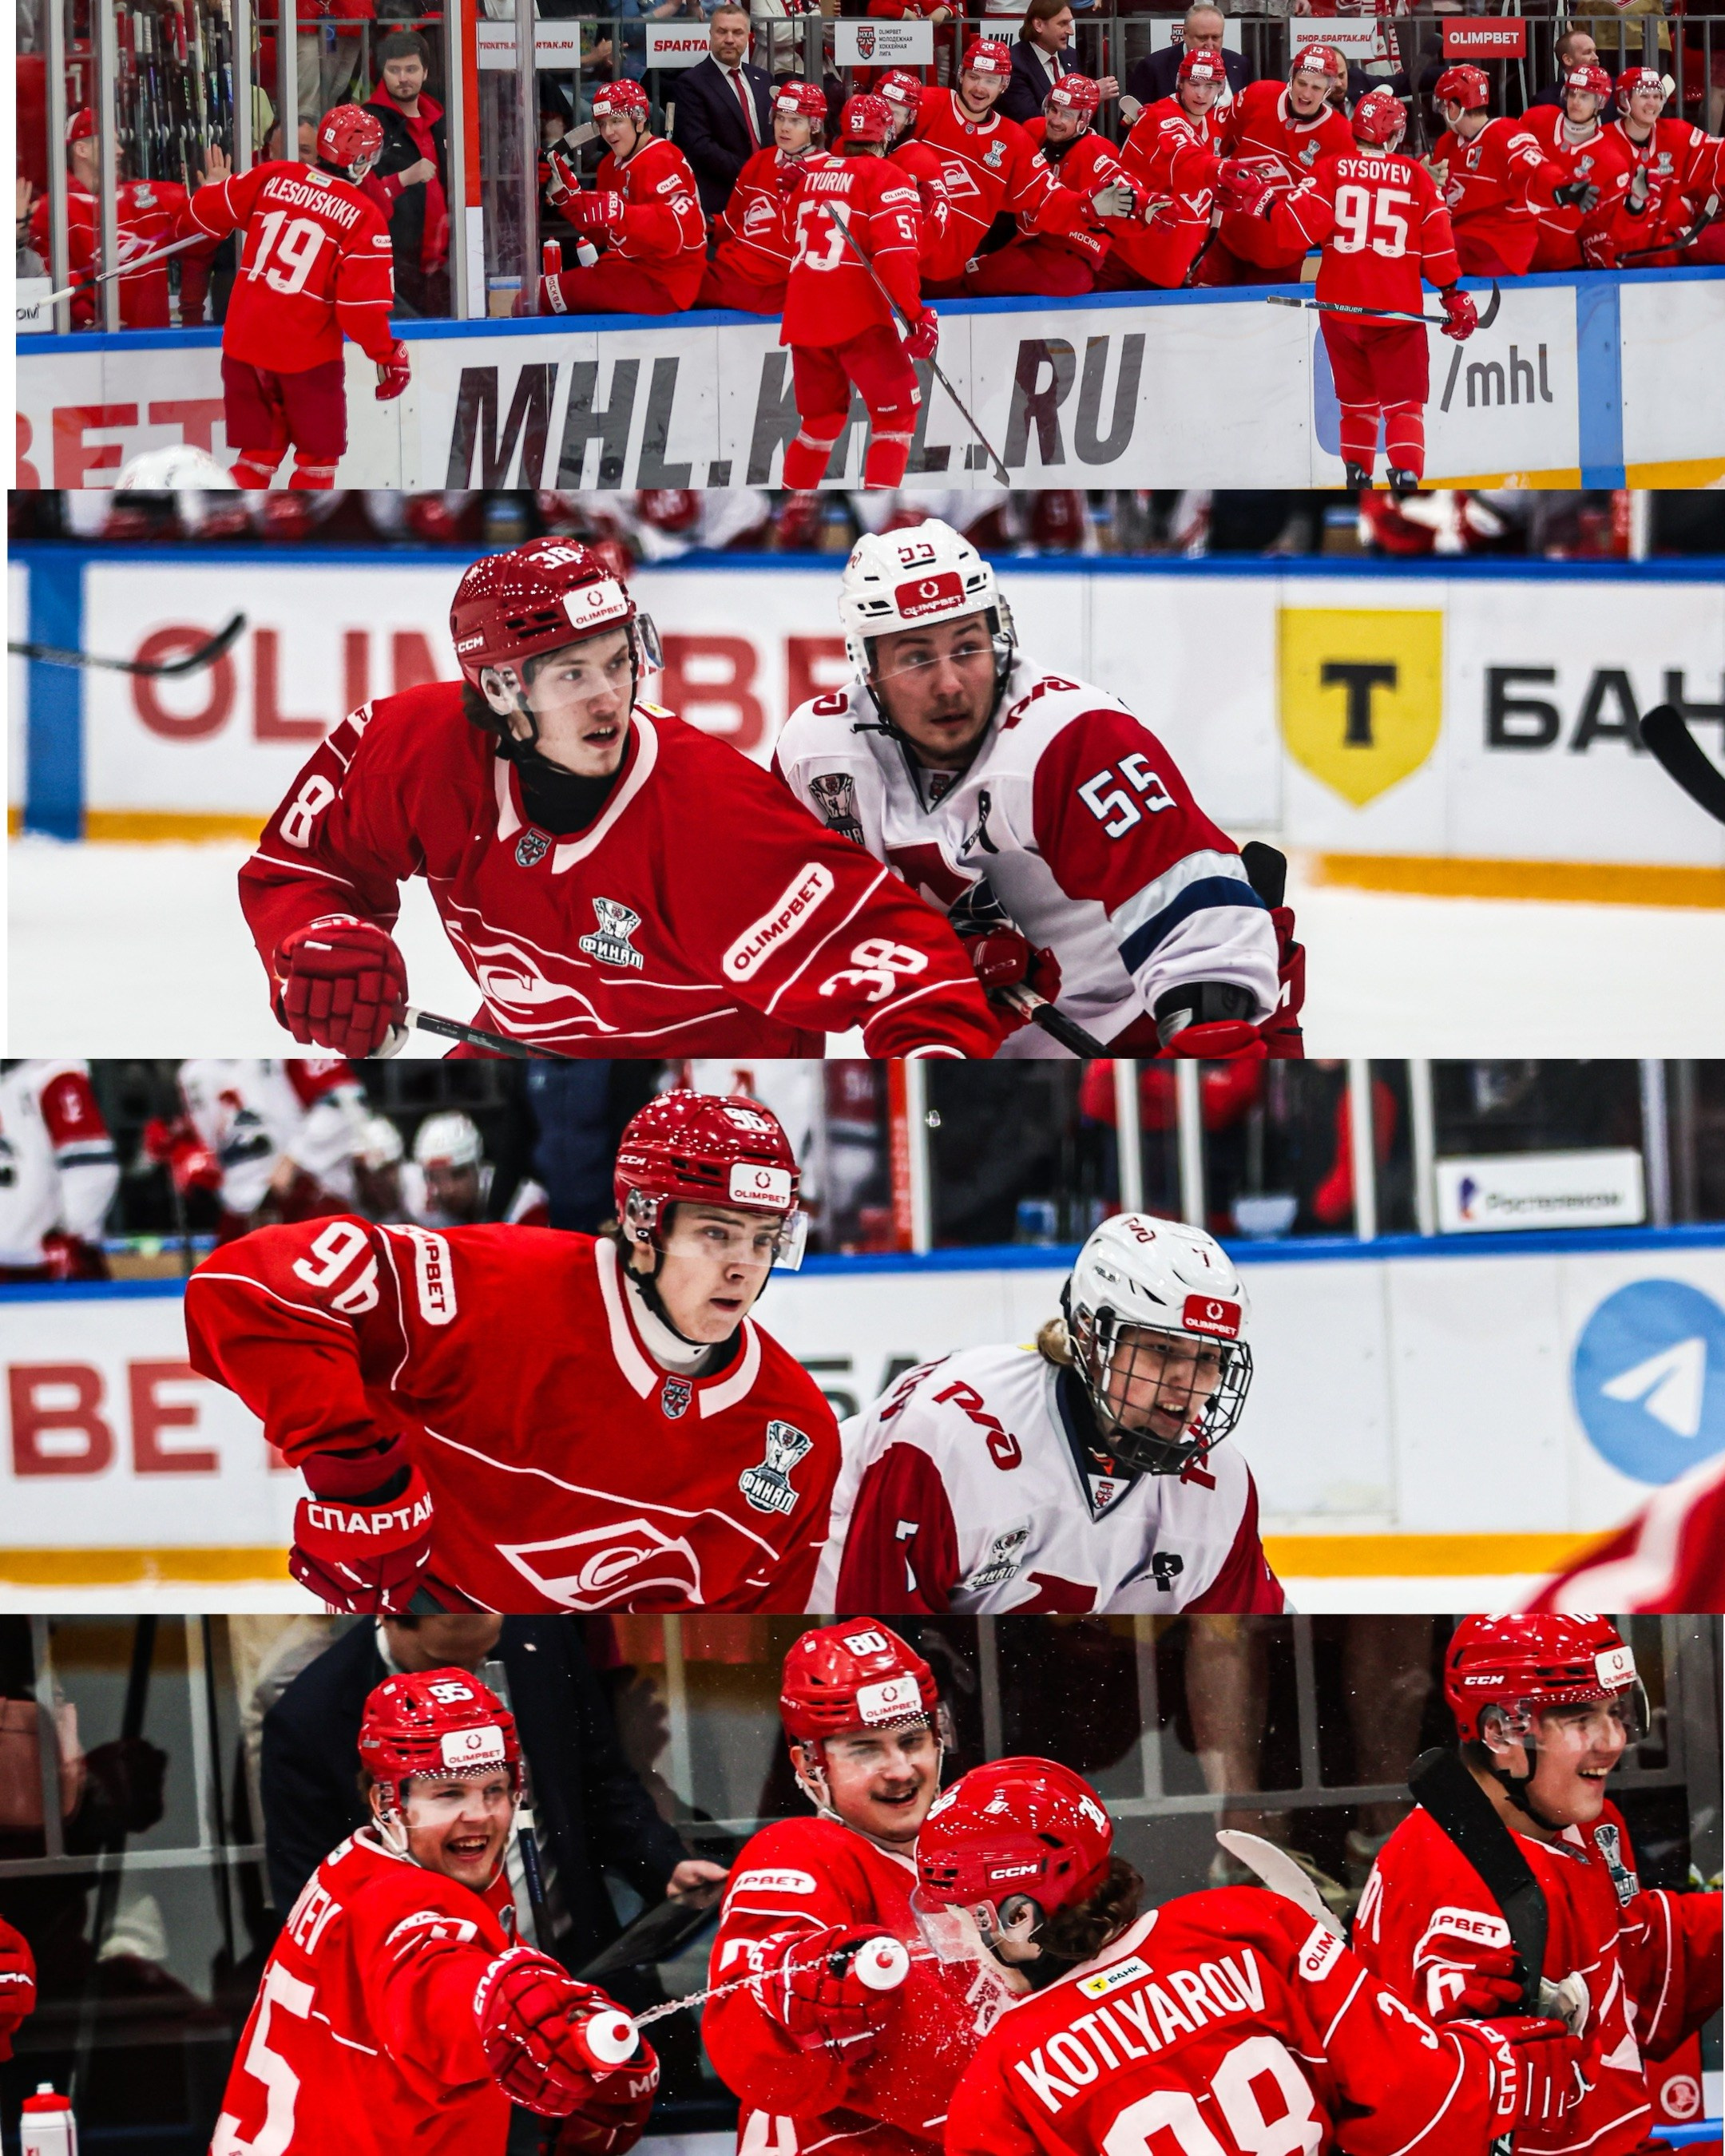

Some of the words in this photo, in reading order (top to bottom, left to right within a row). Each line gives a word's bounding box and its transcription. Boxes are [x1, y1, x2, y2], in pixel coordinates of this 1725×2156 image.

[653, 39, 712, 53] SPARTA
[1296, 34, 1372, 43] SHOP.SPARTAK.RU
[1449, 31, 1519, 44] OLIMPBET
[851, 115, 865, 129] 53
[324, 127, 336, 143] 19
[803, 172, 855, 193] TYURIN
[1336, 158, 1412, 185] SYSOYEV
[263, 176, 362, 230] PLESOVSKIKH
[1333, 184, 1411, 258] 95
[788, 199, 852, 273] 53
[1069, 231, 1101, 253] МОСКВА
[246, 209, 327, 295] 19
[528, 545, 582, 569] 38
[576, 603, 625, 625] OLIMPBET
[903, 594, 964, 616] OLIMPBET
[458, 636, 484, 653] CCM
[1076, 752, 1178, 839] 55
[733, 871, 823, 971] OLIMPBET
[581, 937, 643, 969] ФИНАЛ
[819, 937, 929, 1002] 38
[723, 1107, 769, 1132] 96
[618, 1154, 647, 1165] CCM
[734, 1189, 787, 1204] OLIMPBET
[1185, 1316, 1238, 1337] OLIMPBET
[744, 1472, 796, 1514] ФИНАЛ
[307, 1491, 434, 1535] СПАРТАК
[843, 1631, 888, 1657] 80
[1464, 1674, 1505, 1686] CCM
[427, 1682, 474, 1704] 95
[866, 1699, 918, 1718] OLIMPBET
[449, 1749, 502, 1764] OLIMPBET
[990, 1864, 1037, 1880] CCM
[1307, 1931, 1336, 1972] OLIM
[1108, 1964, 1143, 1984] БАНК
[1014, 1948, 1265, 2114] KOTLYAROV
